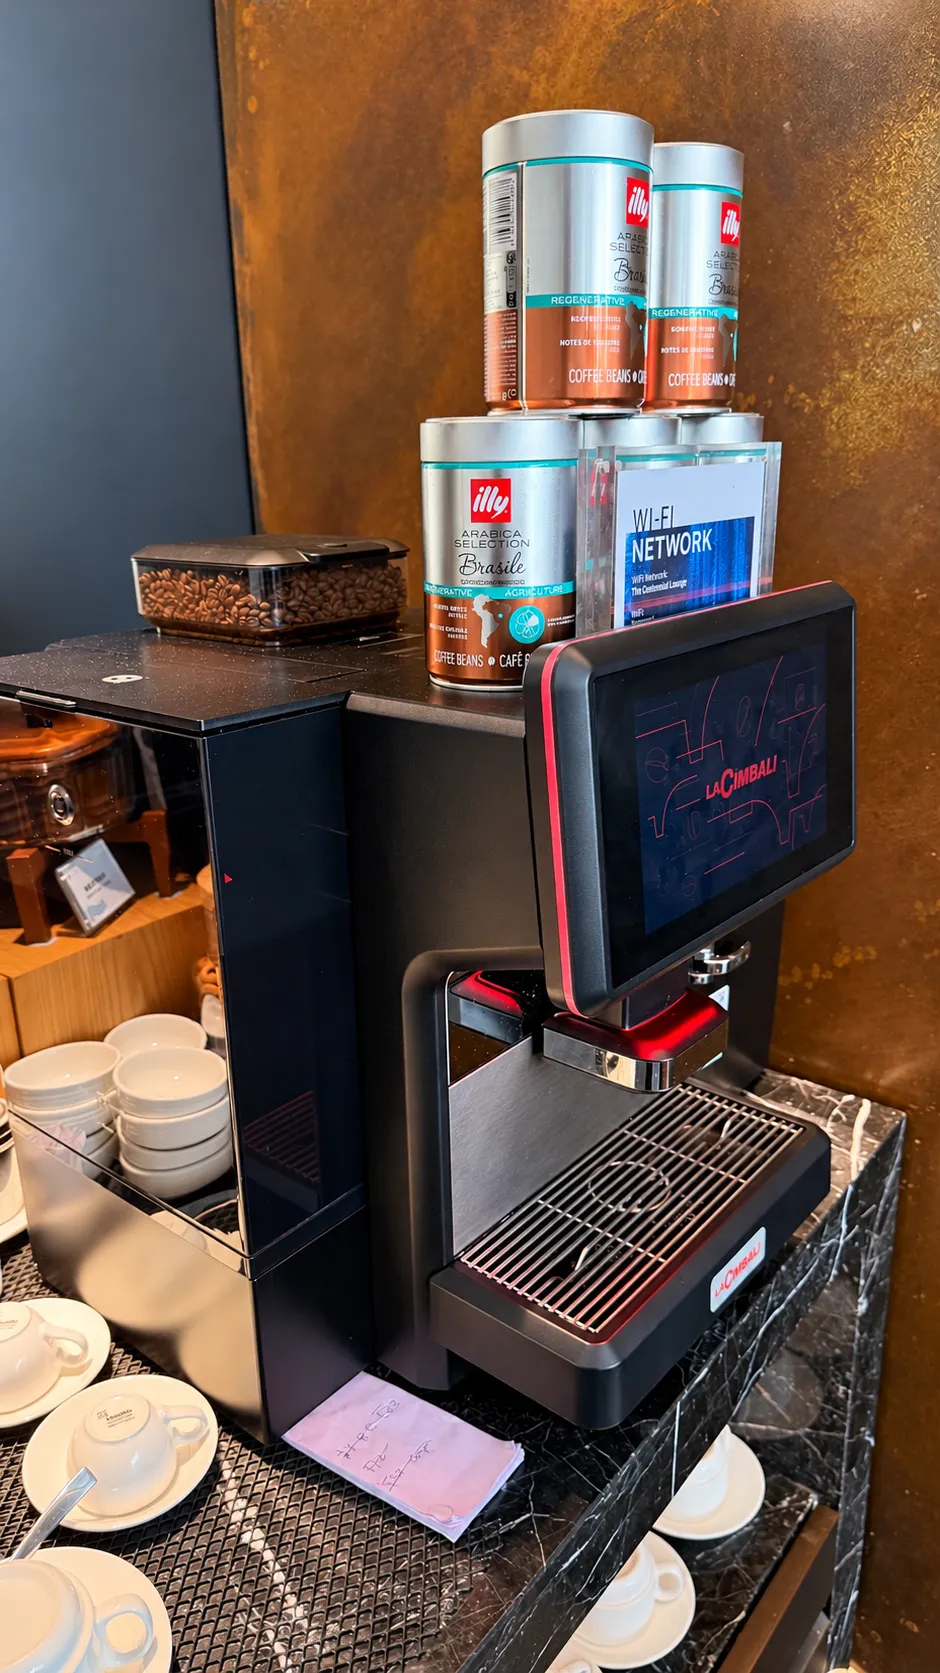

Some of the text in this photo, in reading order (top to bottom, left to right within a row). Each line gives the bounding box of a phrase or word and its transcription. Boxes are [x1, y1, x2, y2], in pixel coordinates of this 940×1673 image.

[627, 186, 648, 222] illy
[722, 209, 740, 242] illy
[568, 368, 604, 384] COFFEE
[606, 368, 632, 384] BEANS
[668, 373, 700, 387] COFFEE
[702, 372, 724, 387] BEANS
[473, 485, 509, 520] illy
[633, 505, 674, 532] WI-FI
[454, 540, 530, 548] SELECTION
[461, 530, 522, 538] ARABICA
[632, 528, 713, 564] NETWORK
[458, 551, 527, 576] Brasile
[456, 653, 484, 668] BEANS
[499, 651, 524, 668] CAFÉ
